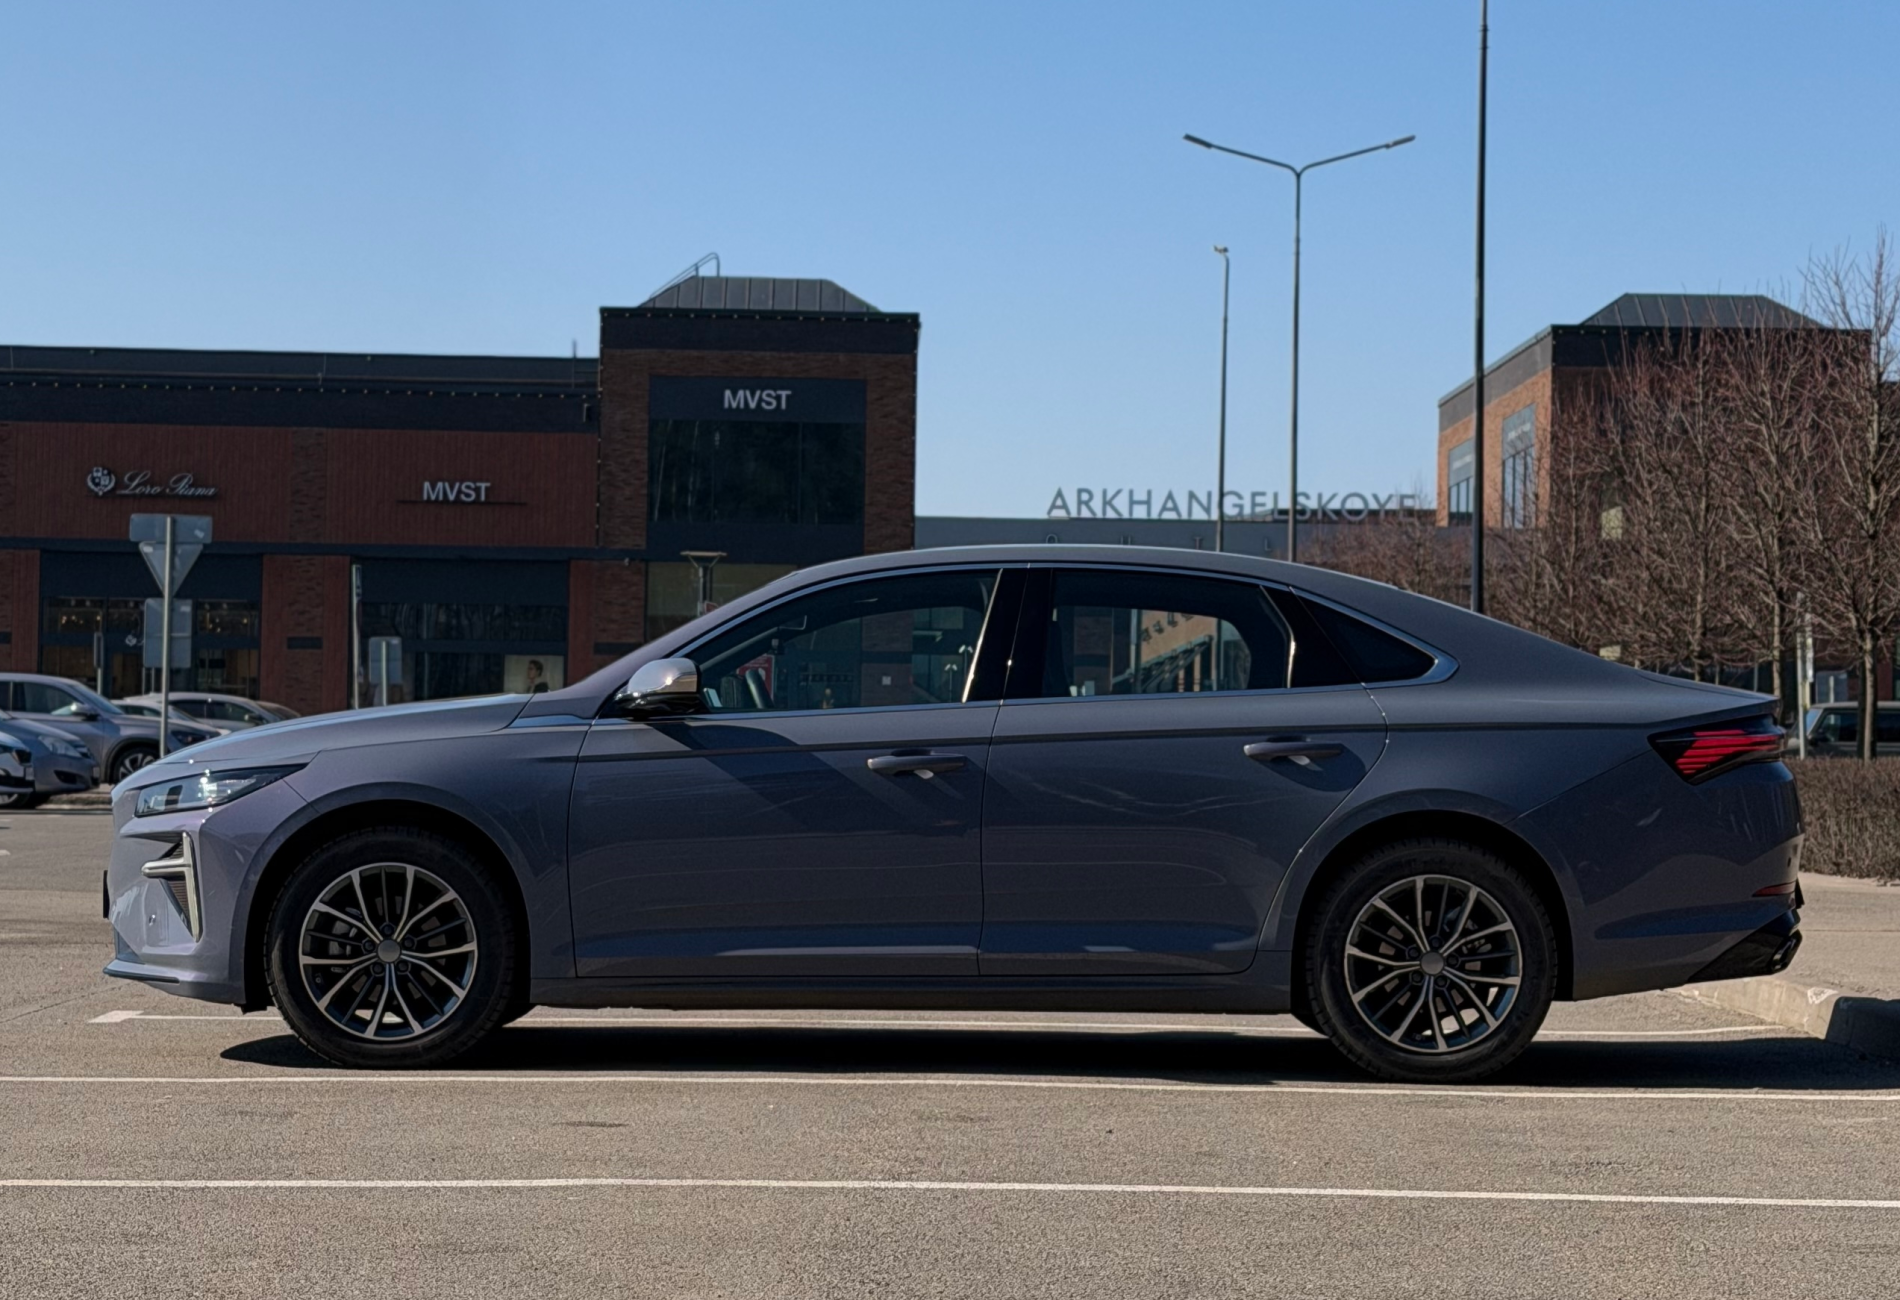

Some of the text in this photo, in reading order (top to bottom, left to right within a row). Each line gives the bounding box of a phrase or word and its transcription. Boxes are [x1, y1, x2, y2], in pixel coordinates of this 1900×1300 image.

[723, 389, 792, 410] MVST
[116, 470, 218, 496] Loro Piana
[422, 481, 491, 502] MVST
[1046, 486, 1418, 522] ARKHANGELSKOYE
